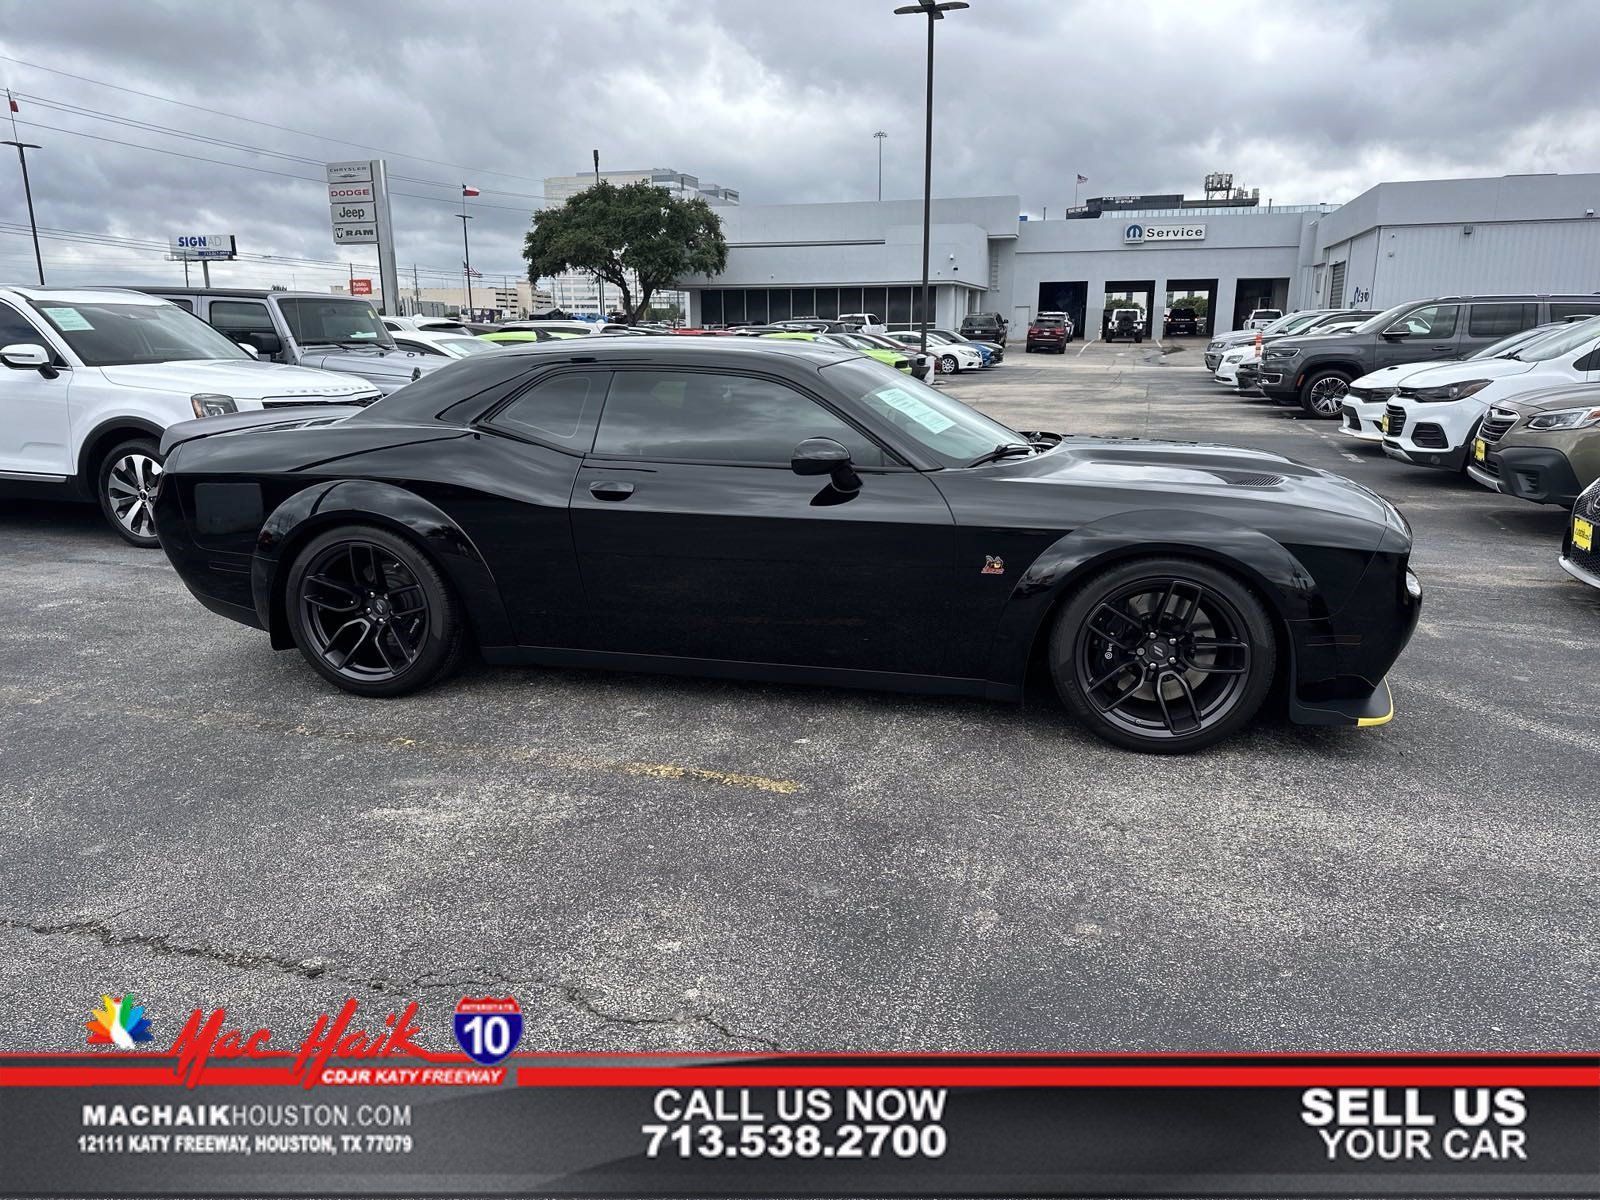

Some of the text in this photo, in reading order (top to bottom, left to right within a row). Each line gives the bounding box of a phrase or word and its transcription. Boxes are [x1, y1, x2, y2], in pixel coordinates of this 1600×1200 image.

[331, 189, 369, 197] DODGE
[339, 207, 365, 219] Jeep
[1147, 227, 1203, 238] Service
